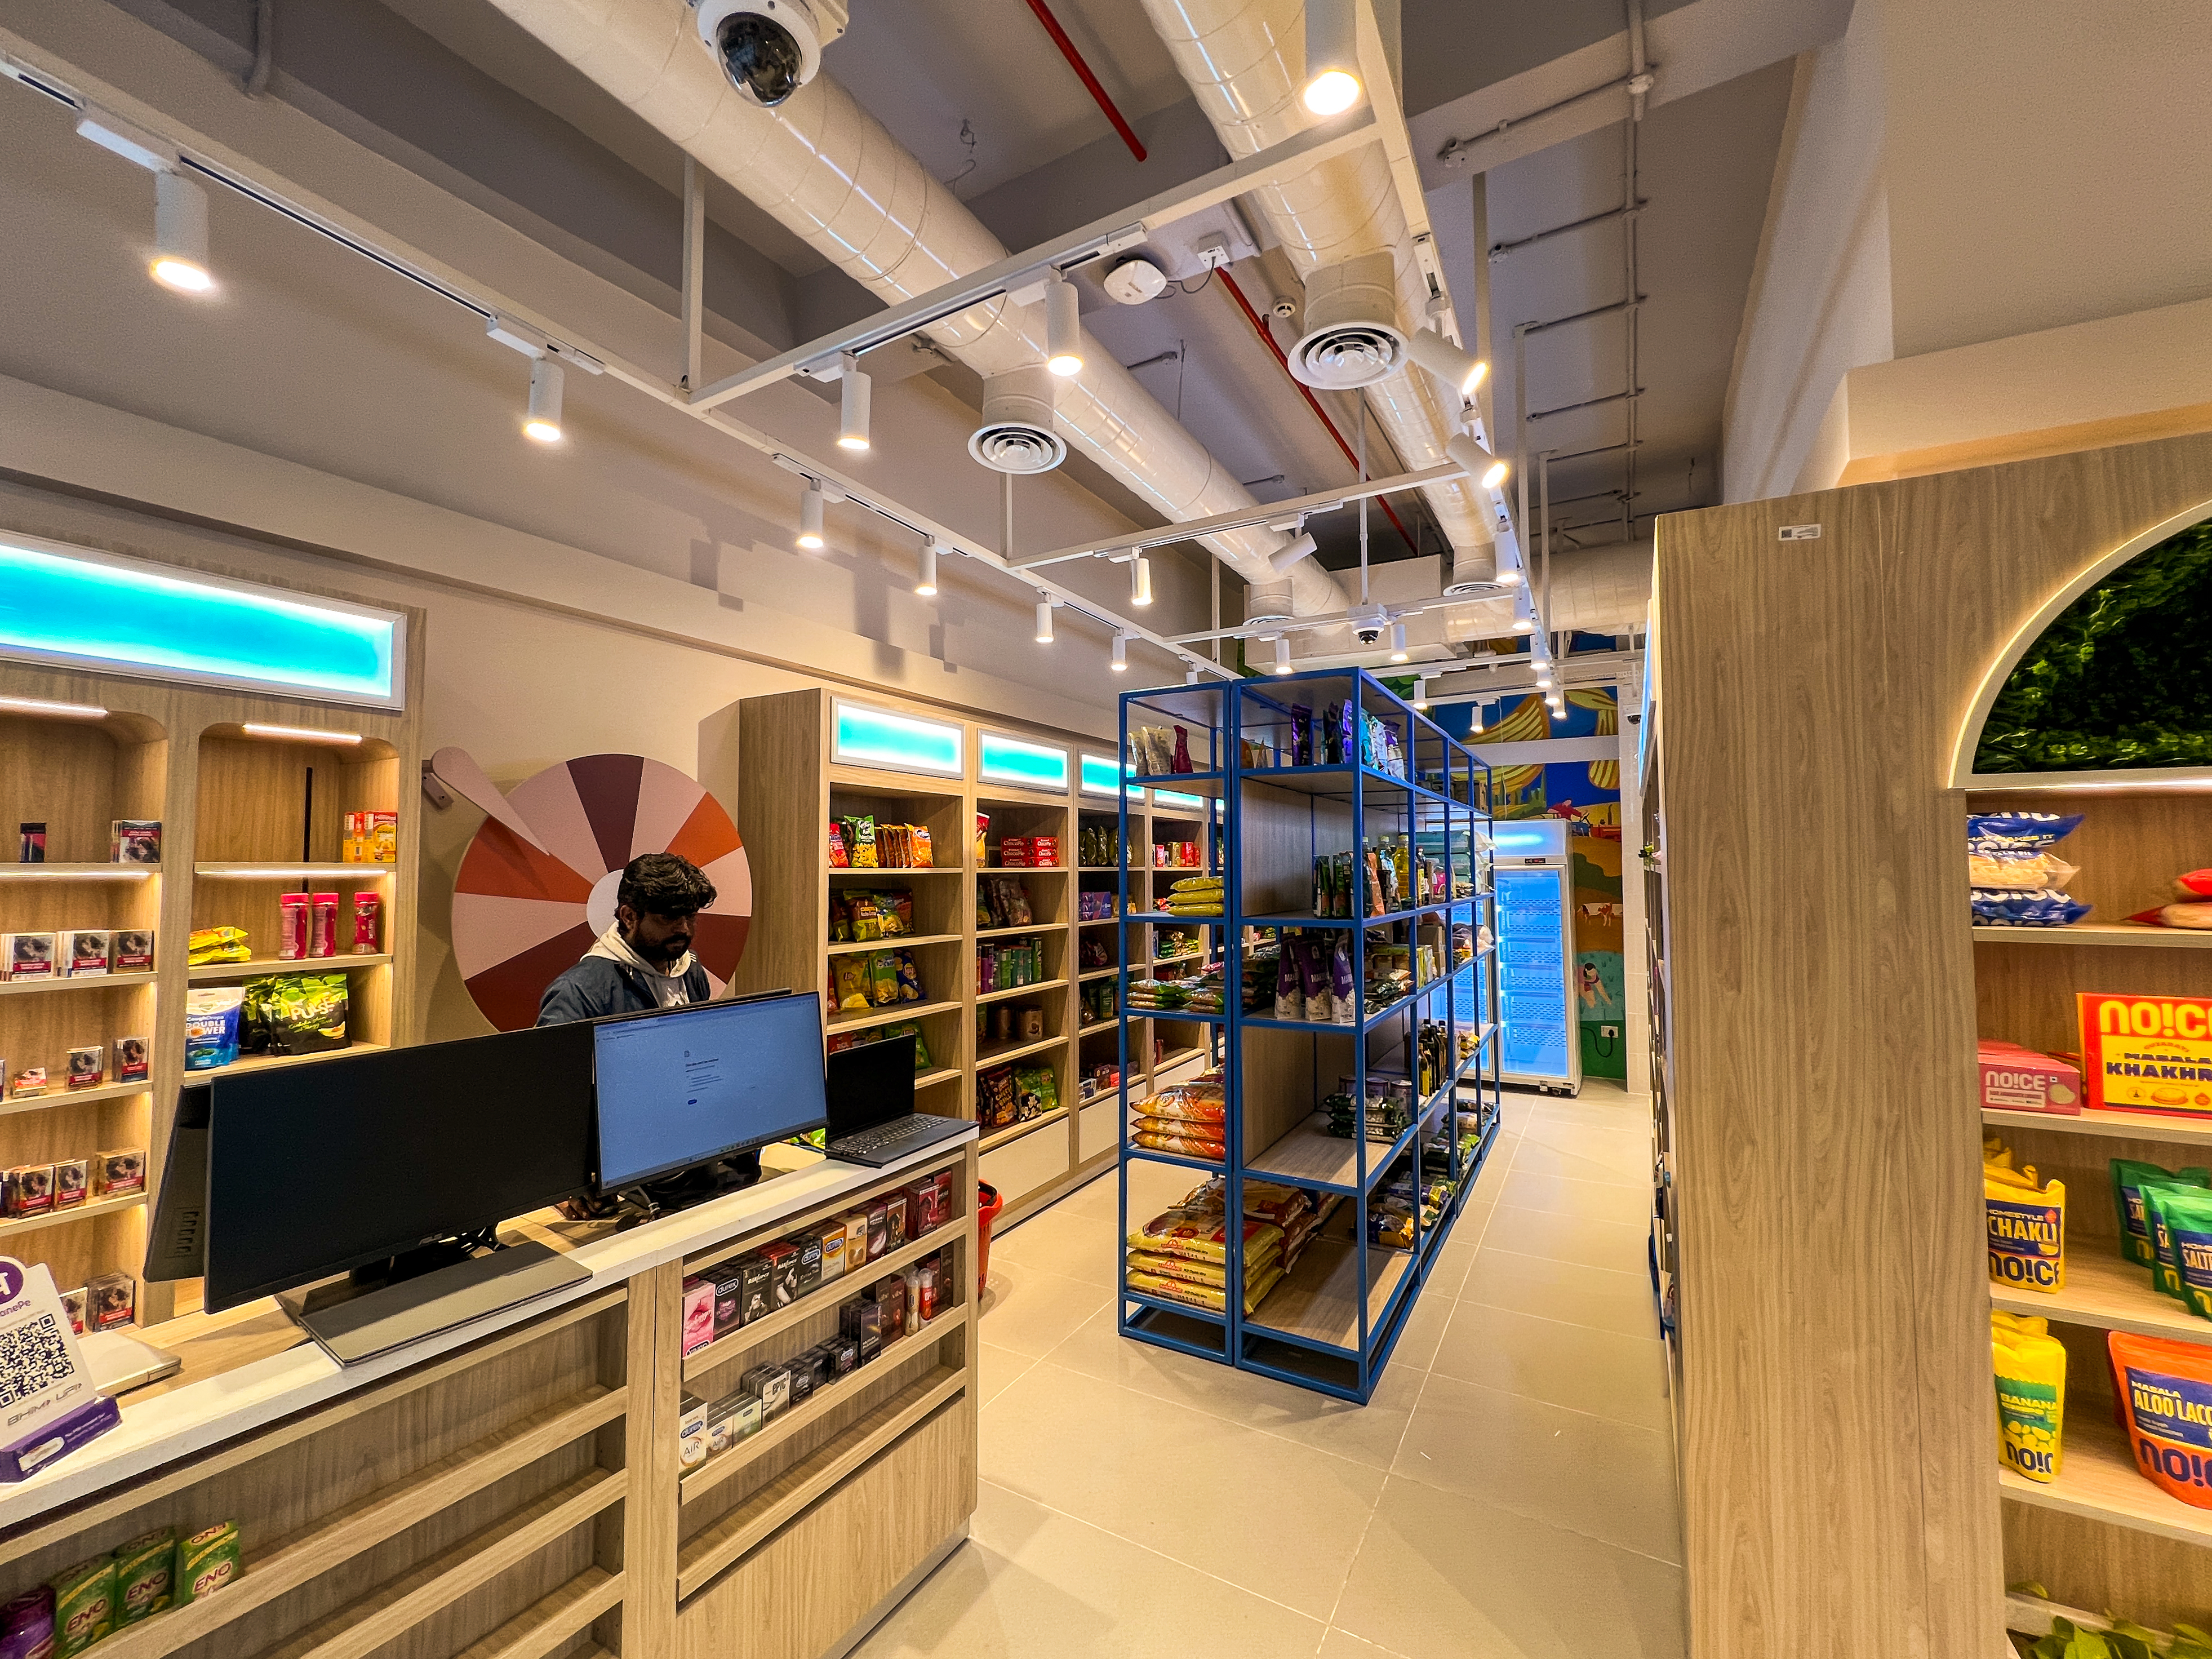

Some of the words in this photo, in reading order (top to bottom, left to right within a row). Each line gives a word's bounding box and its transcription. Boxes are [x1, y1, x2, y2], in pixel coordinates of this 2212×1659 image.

[2100, 1000, 2212, 1039] NO!C
[717, 1280, 736, 1294] durex
[772, 1378, 787, 1395] EPIC
[2131, 1381, 2182, 1399] MASALA
[2134, 1389, 2175, 1418] ALOO
[127, 1572, 166, 1600] ENO
[194, 1563, 232, 1592] ENO
[67, 1598, 107, 1633] ENO
